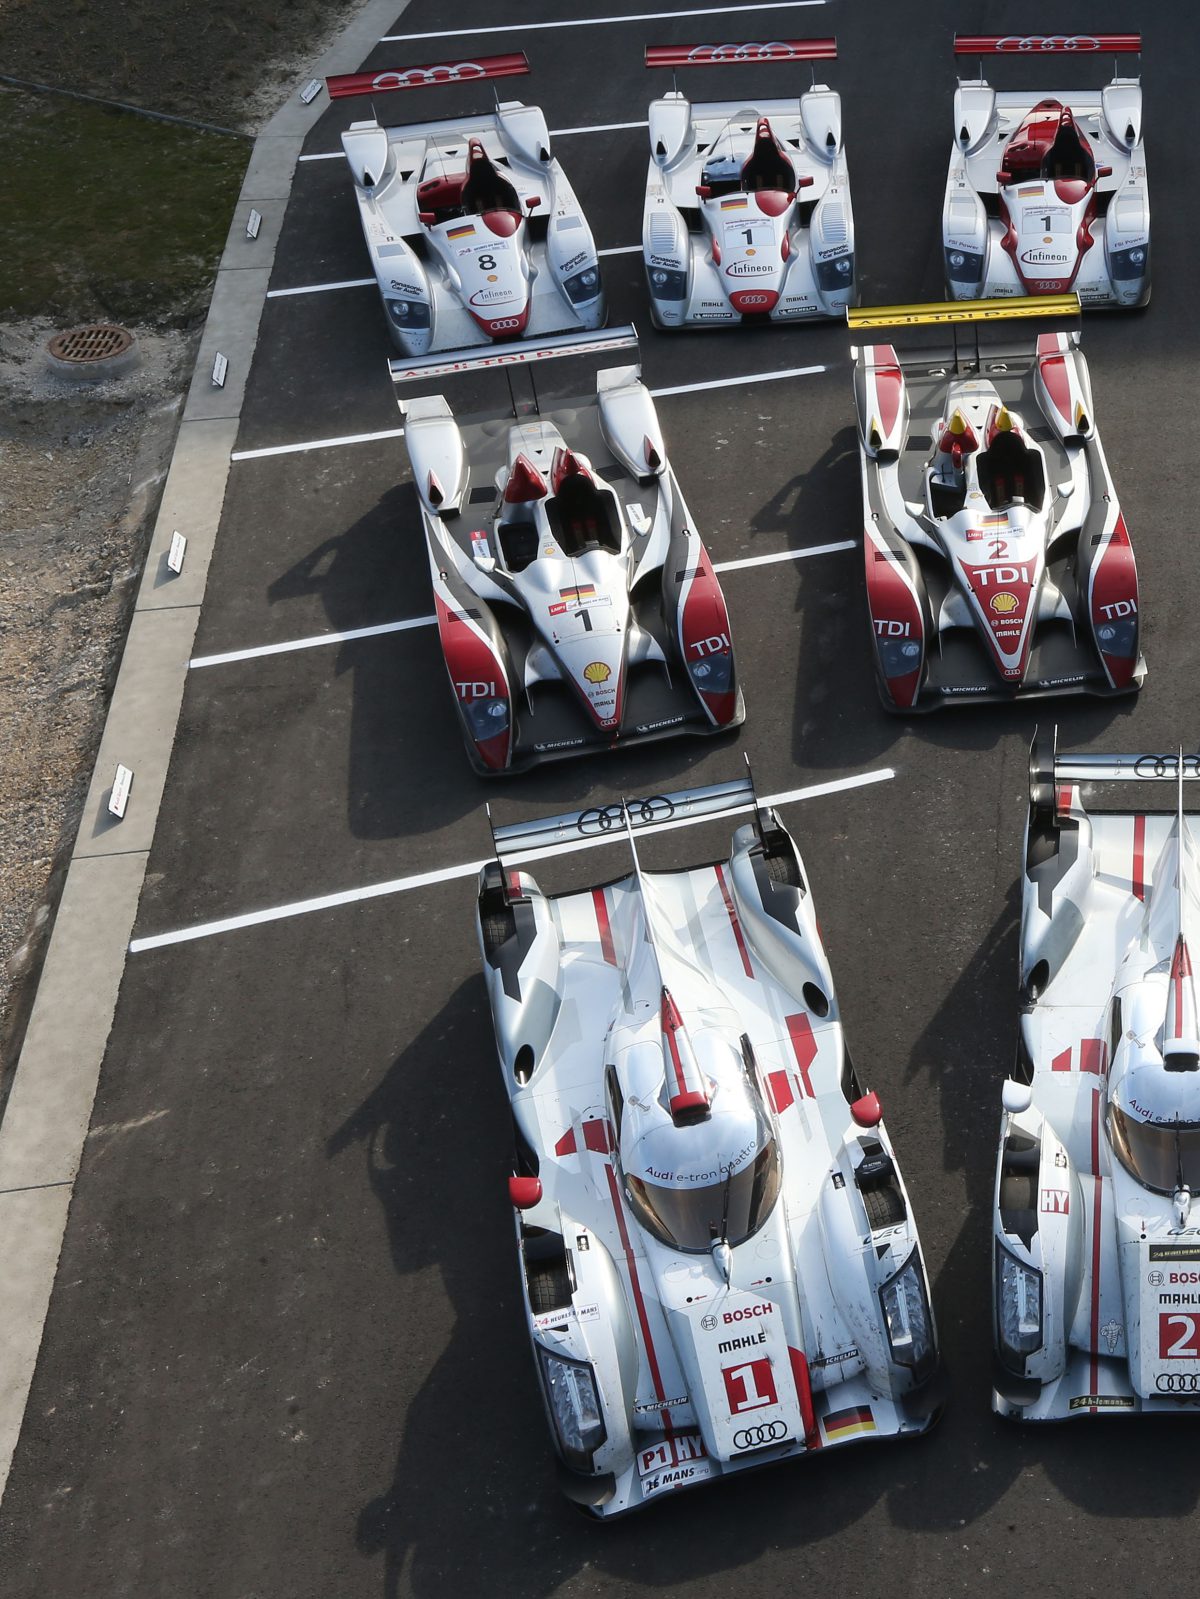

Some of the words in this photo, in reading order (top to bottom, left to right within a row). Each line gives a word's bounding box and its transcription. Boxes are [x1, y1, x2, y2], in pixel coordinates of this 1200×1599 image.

[1040, 215, 1051, 232] 1
[741, 228, 753, 245] 1
[818, 243, 849, 257] Panasonic
[478, 254, 497, 271] 8
[560, 251, 587, 271] Panasonic
[650, 254, 682, 265] Panasonic
[390, 279, 424, 294] Panasonic
[858, 316, 918, 326] Audi
[929, 313, 973, 321] TDI
[403, 363, 467, 377] Audi
[477, 353, 525, 366] TDI
[987, 540, 1009, 560] 2
[972, 566, 1029, 586] TDI
[1100, 598, 1138, 620] TDI
[574, 609, 593, 632] 1
[873, 619, 910, 637] TDI
[1000, 618, 1024, 626] BOSCH
[995, 630, 1021, 638] MAHLE
[690, 633, 730, 657] TDI
[456, 681, 496, 698] TDI
[1050, 675, 1084, 686] MICHELIN
[595, 687, 616, 696] BOSCH
[593, 699, 615, 708] MAHLE
[648, 716, 684, 730] MICHELIN
[546, 738, 583, 749] MICHELIN
[1129, 1099, 1154, 1119] Audi
[645, 1166, 674, 1181] Audi
[676, 1171, 718, 1182] e-tron
[720, 1140, 757, 1175] quattro
[1041, 1189, 1069, 1214] HY
[723, 1302, 773, 1325] BOSCH
[718, 1332, 767, 1354] MAHLE
[1167, 1314, 1198, 1357] 2
[822, 1349, 858, 1364] ICHELIN
[730, 1364, 771, 1411] 1
[646, 1395, 689, 1411] MICHELIN
[674, 1434, 703, 1461] HY
[642, 1446, 667, 1471] P1
[662, 1467, 695, 1485] MANS
